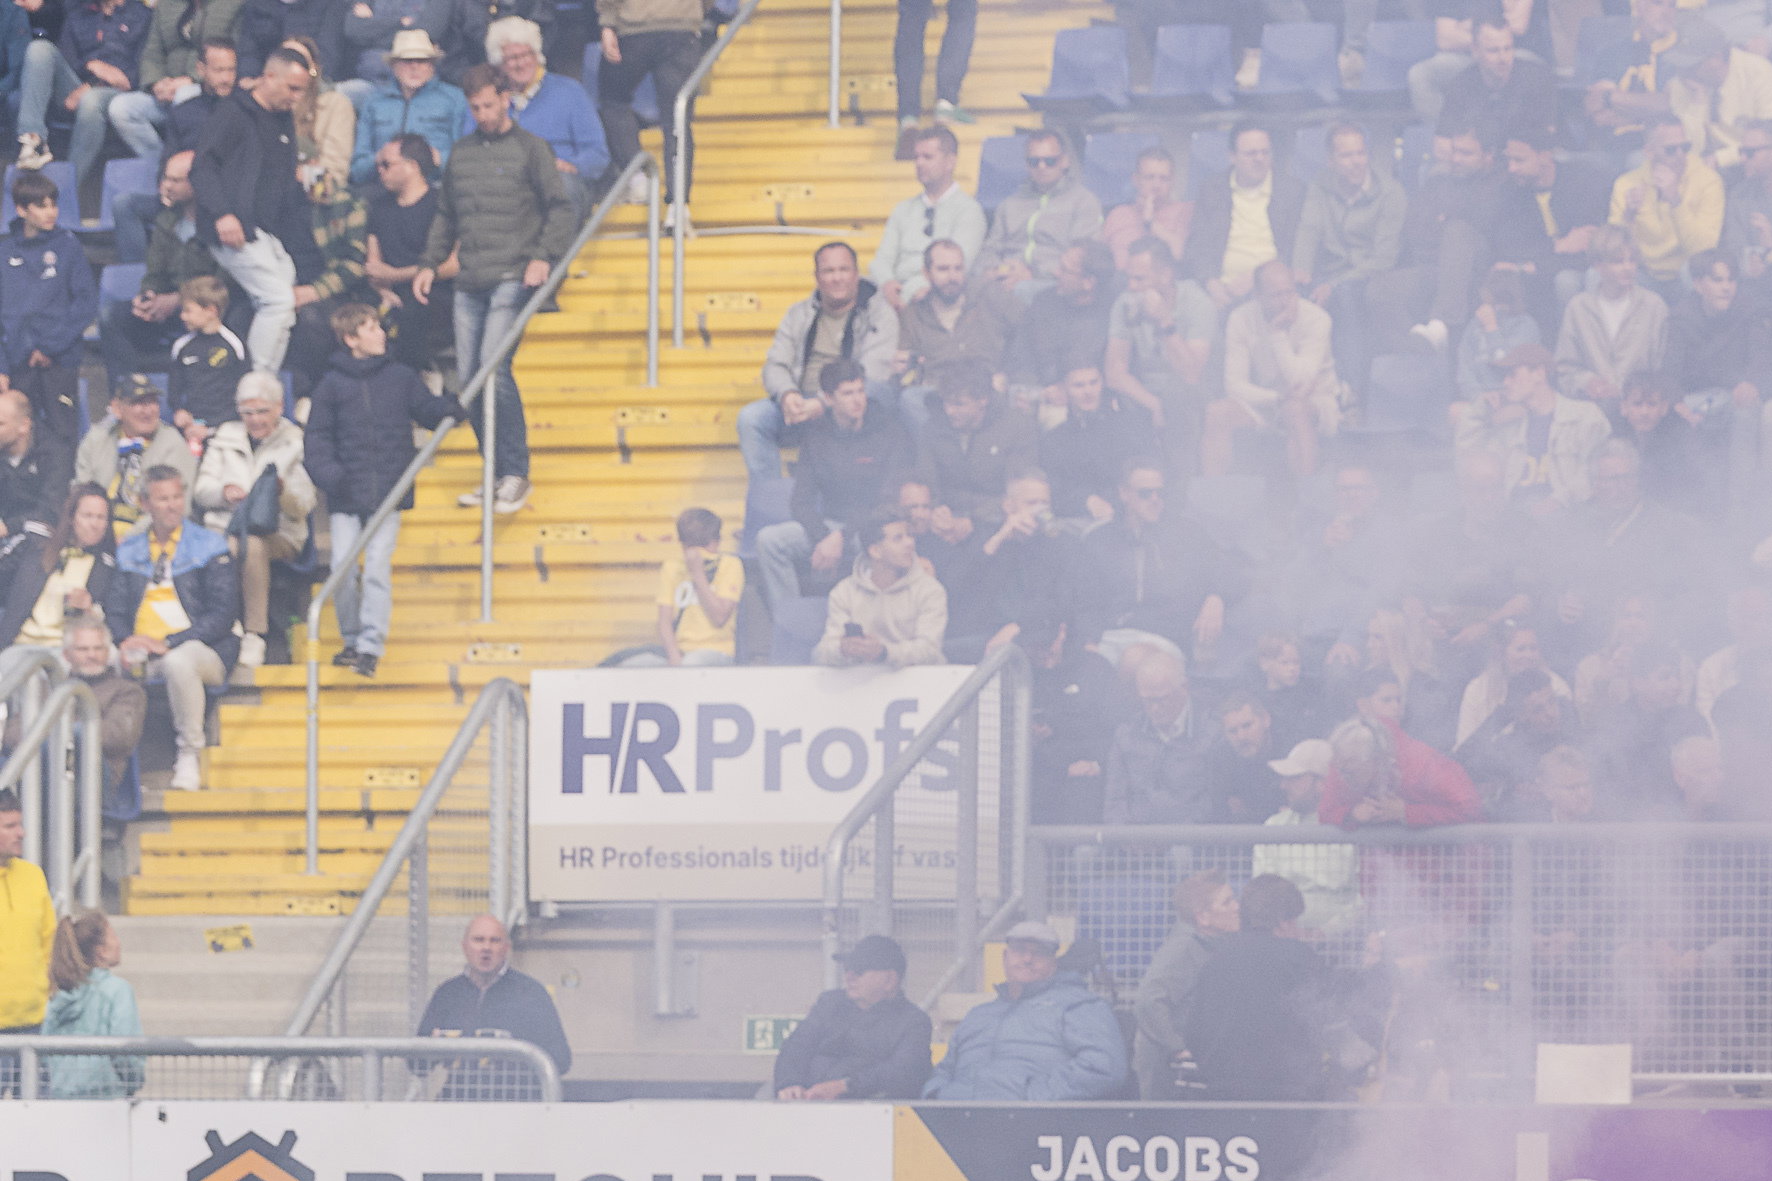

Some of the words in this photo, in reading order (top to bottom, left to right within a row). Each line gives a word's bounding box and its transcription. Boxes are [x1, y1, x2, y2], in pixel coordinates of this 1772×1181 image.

[559, 847, 594, 869] HR
[602, 846, 773, 869] Professionals
[912, 849, 962, 869] vas
